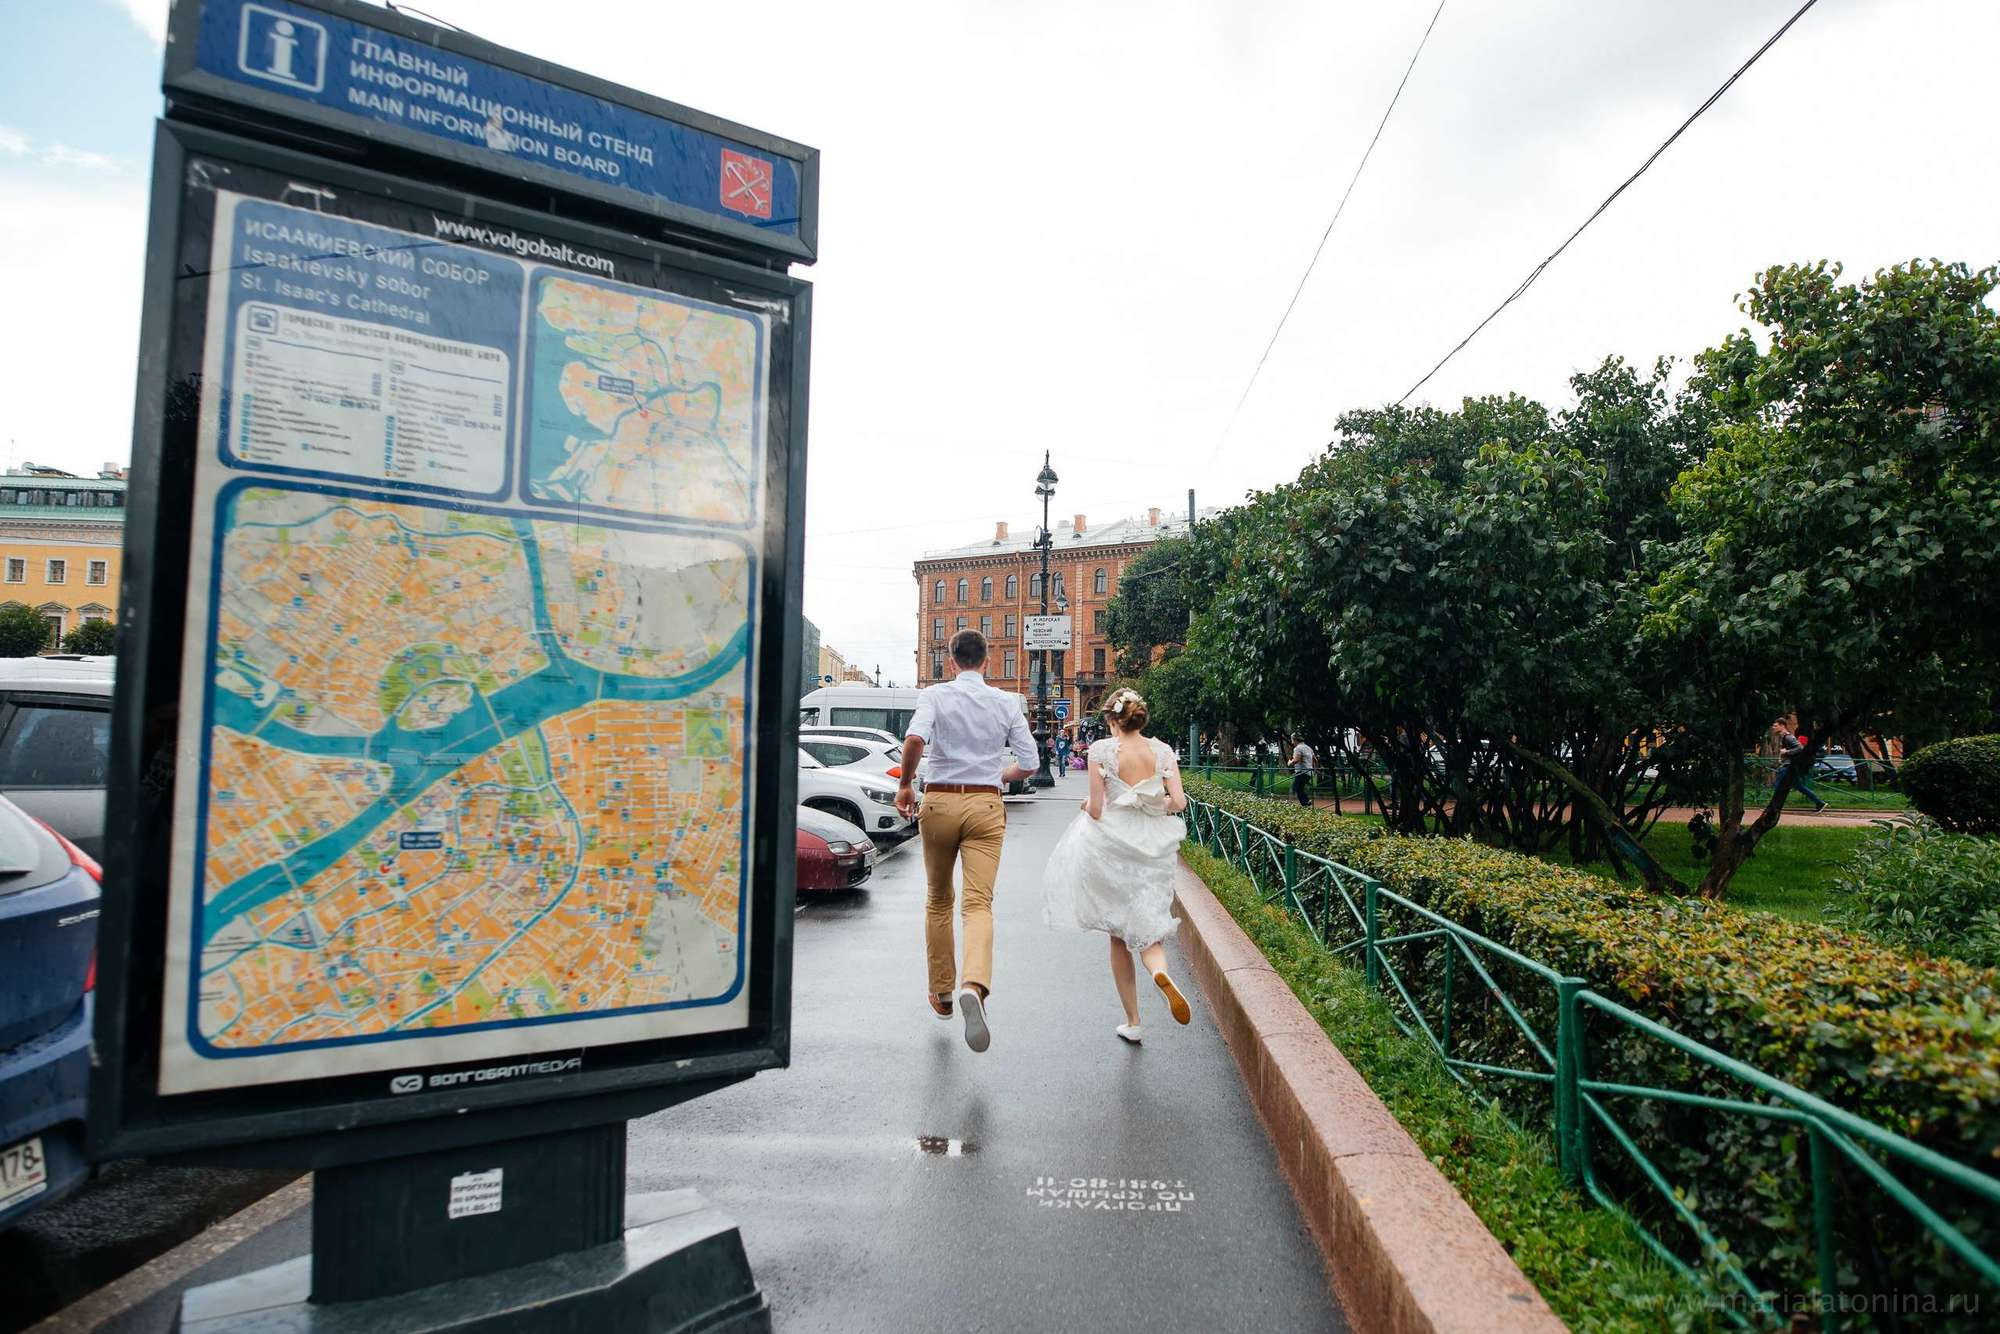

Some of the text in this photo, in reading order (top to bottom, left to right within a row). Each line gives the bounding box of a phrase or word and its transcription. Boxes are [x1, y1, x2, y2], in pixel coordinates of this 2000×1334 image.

[351, 37, 469, 87] ГЛАВНЫЙ
[347, 87, 621, 178] MAIN INFORMTION BOARD
[350, 60, 655, 167] ИНФОРМАЦИОННЫЙ СТЕНД
[242, 244, 432, 301] Isaakievsky sobor
[244, 218, 491, 285] ИСААКИЕВСКИЙ СОБОР
[433, 214, 615, 276] www.volgobalt.com
[240, 271, 430, 326] St. Isaac's Cathedral
[1026, 1187, 1195, 1201] ПО КРЫШАМ
[1039, 1199, 1181, 1212] ПРОГУЛКИ
